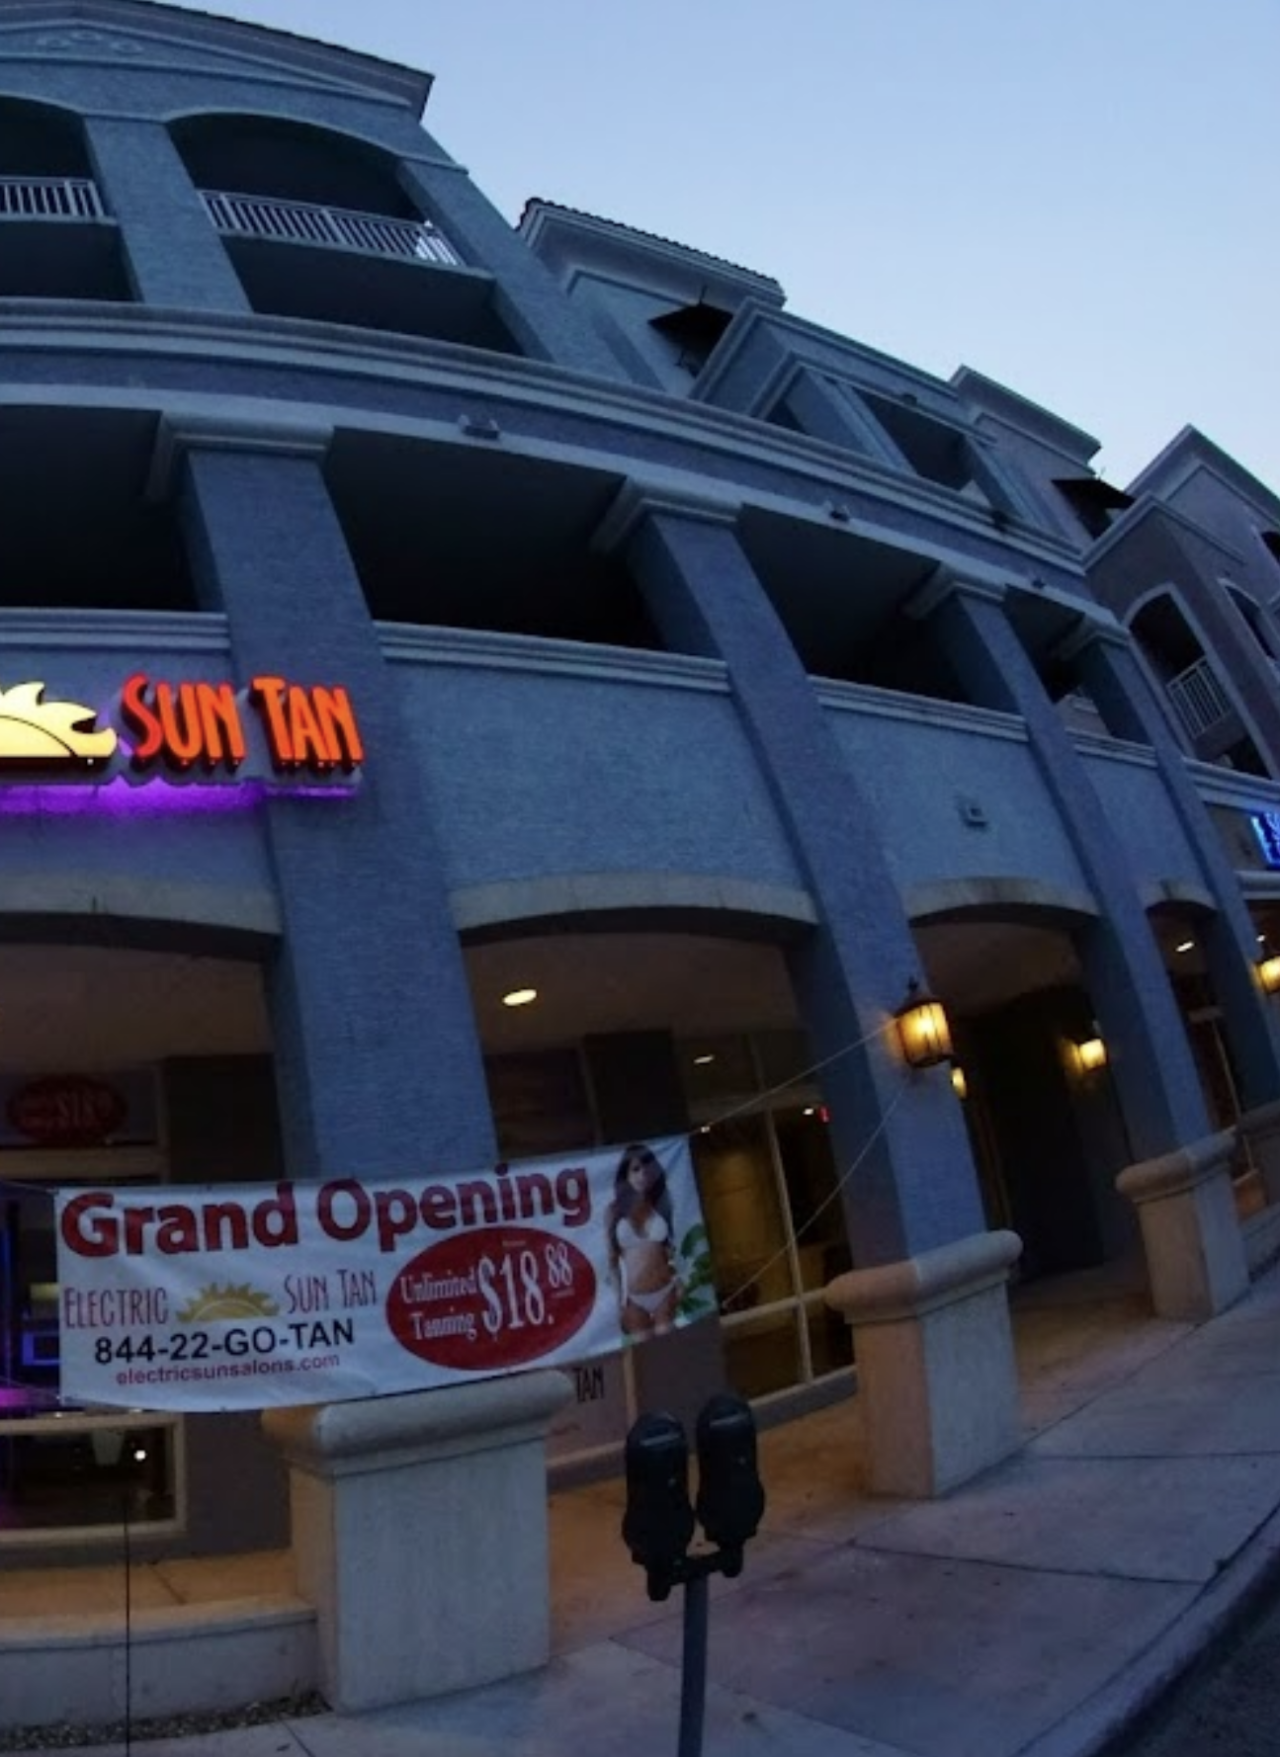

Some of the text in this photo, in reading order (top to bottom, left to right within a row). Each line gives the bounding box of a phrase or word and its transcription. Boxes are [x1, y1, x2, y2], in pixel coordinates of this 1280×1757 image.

[122, 673, 246, 768] SUN
[252, 676, 363, 768] TAN
[60, 1165, 592, 1257] Grand Opening
[64, 1269, 377, 1329] ELECTRIC SUN TAN
[400, 1267, 477, 1304] Unlimited
[94, 1318, 354, 1364] 844-22-GO-TAN
[410, 1307, 477, 1341] Tanning
[116, 1354, 340, 1386] electricsunsalons.com
[572, 1366, 604, 1403] TAN
